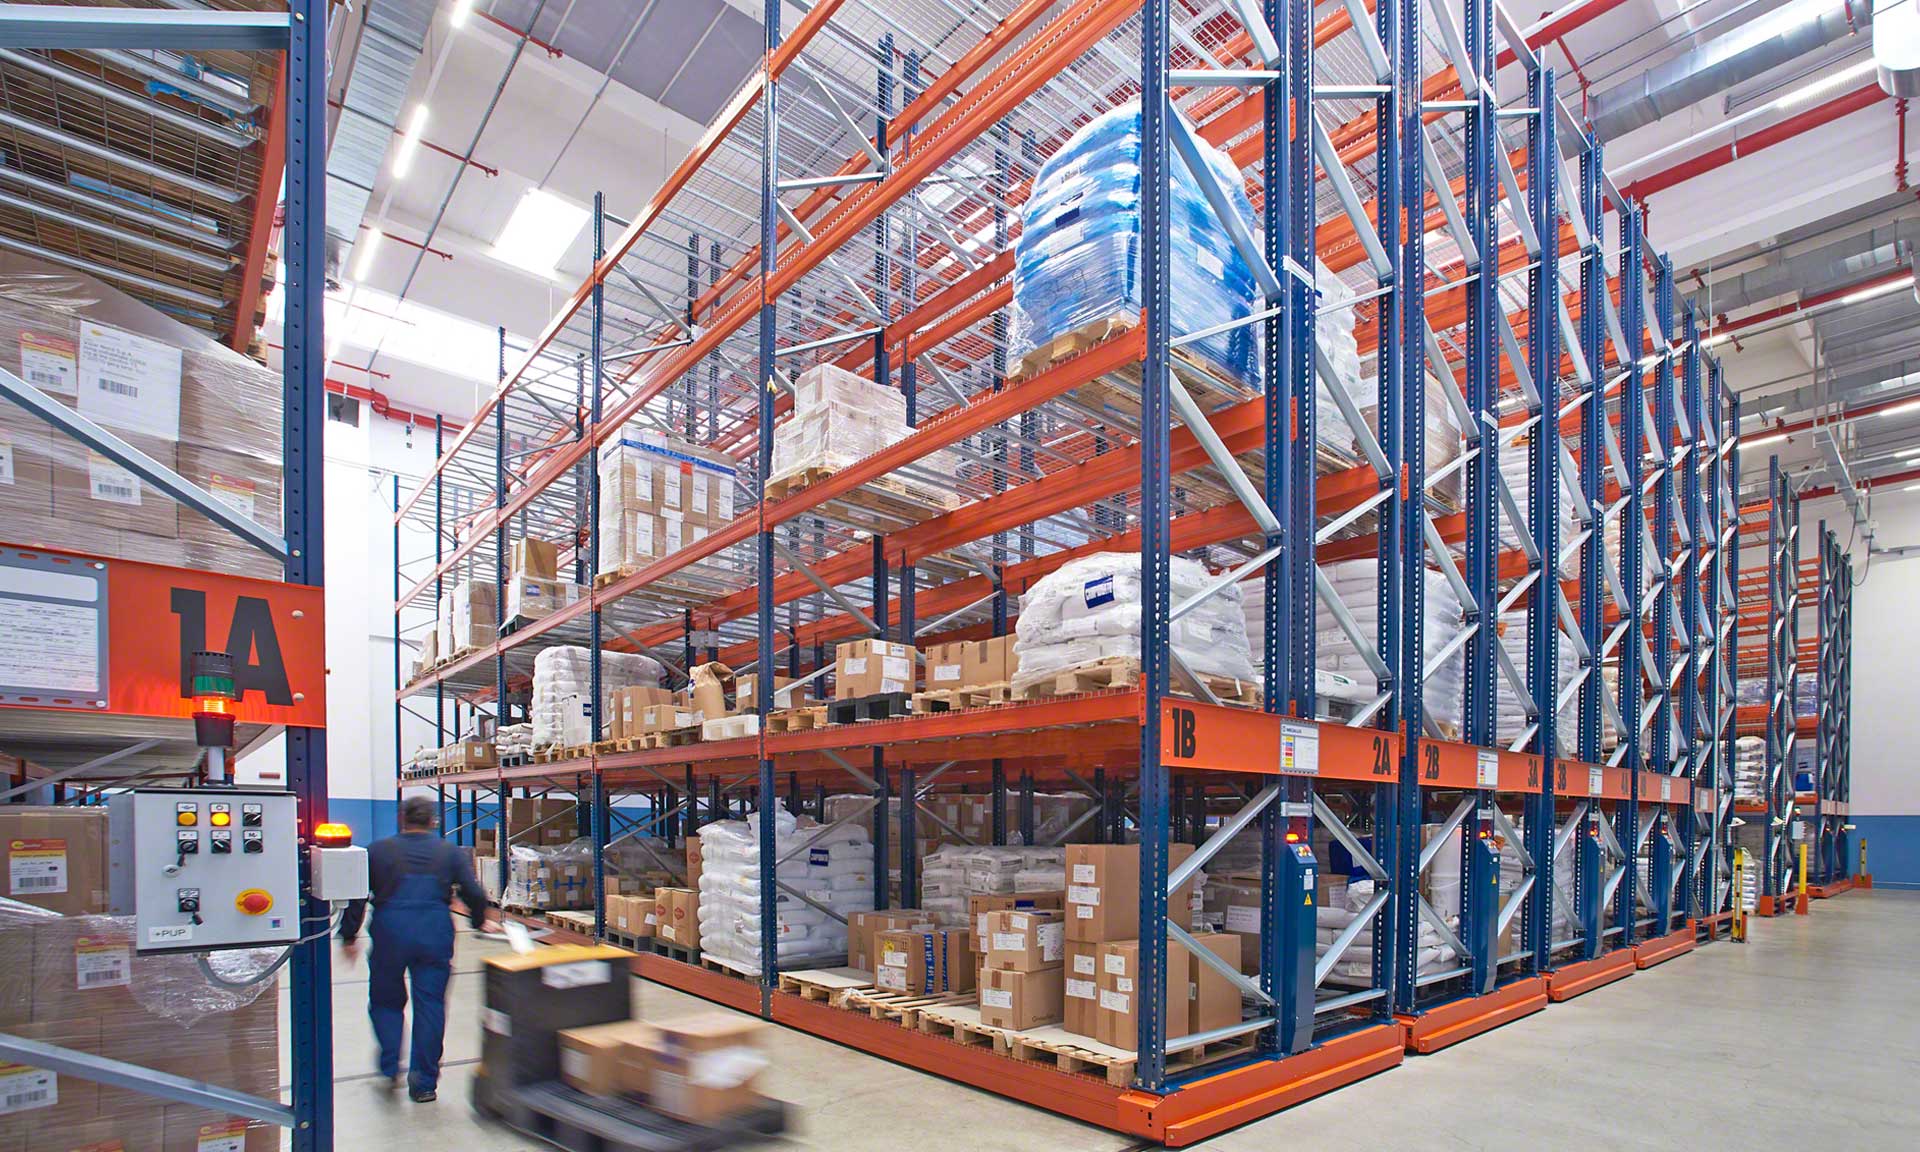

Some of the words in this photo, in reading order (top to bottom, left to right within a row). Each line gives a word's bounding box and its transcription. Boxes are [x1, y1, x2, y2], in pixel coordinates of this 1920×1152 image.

[171, 588, 295, 706] 1A
[1172, 707, 1196, 759] 1B
[1372, 736, 1391, 776] 2A
[1425, 744, 1439, 779] 2B
[1528, 758, 1538, 788] 3A
[155, 928, 187, 938] +PUP
